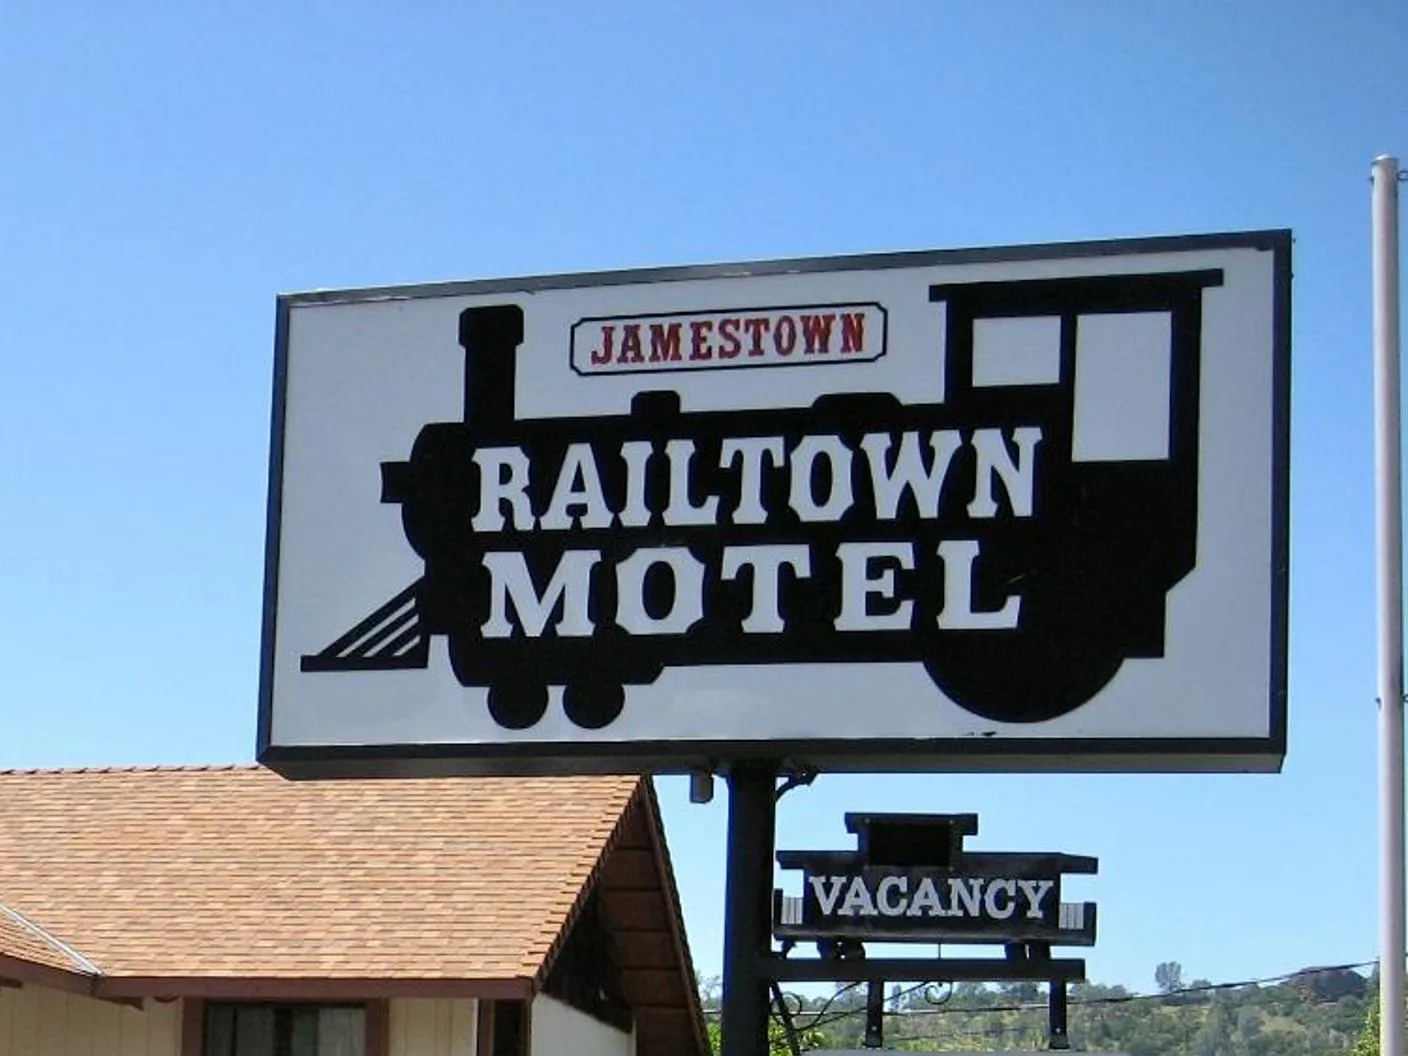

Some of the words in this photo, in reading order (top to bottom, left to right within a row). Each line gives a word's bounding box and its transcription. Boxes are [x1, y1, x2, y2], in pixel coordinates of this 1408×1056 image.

[590, 313, 867, 366] JAMESTOWN
[471, 426, 1043, 533] RAILTOWN
[479, 539, 1022, 640] MOTEL
[810, 875, 1053, 919] VACANCY
